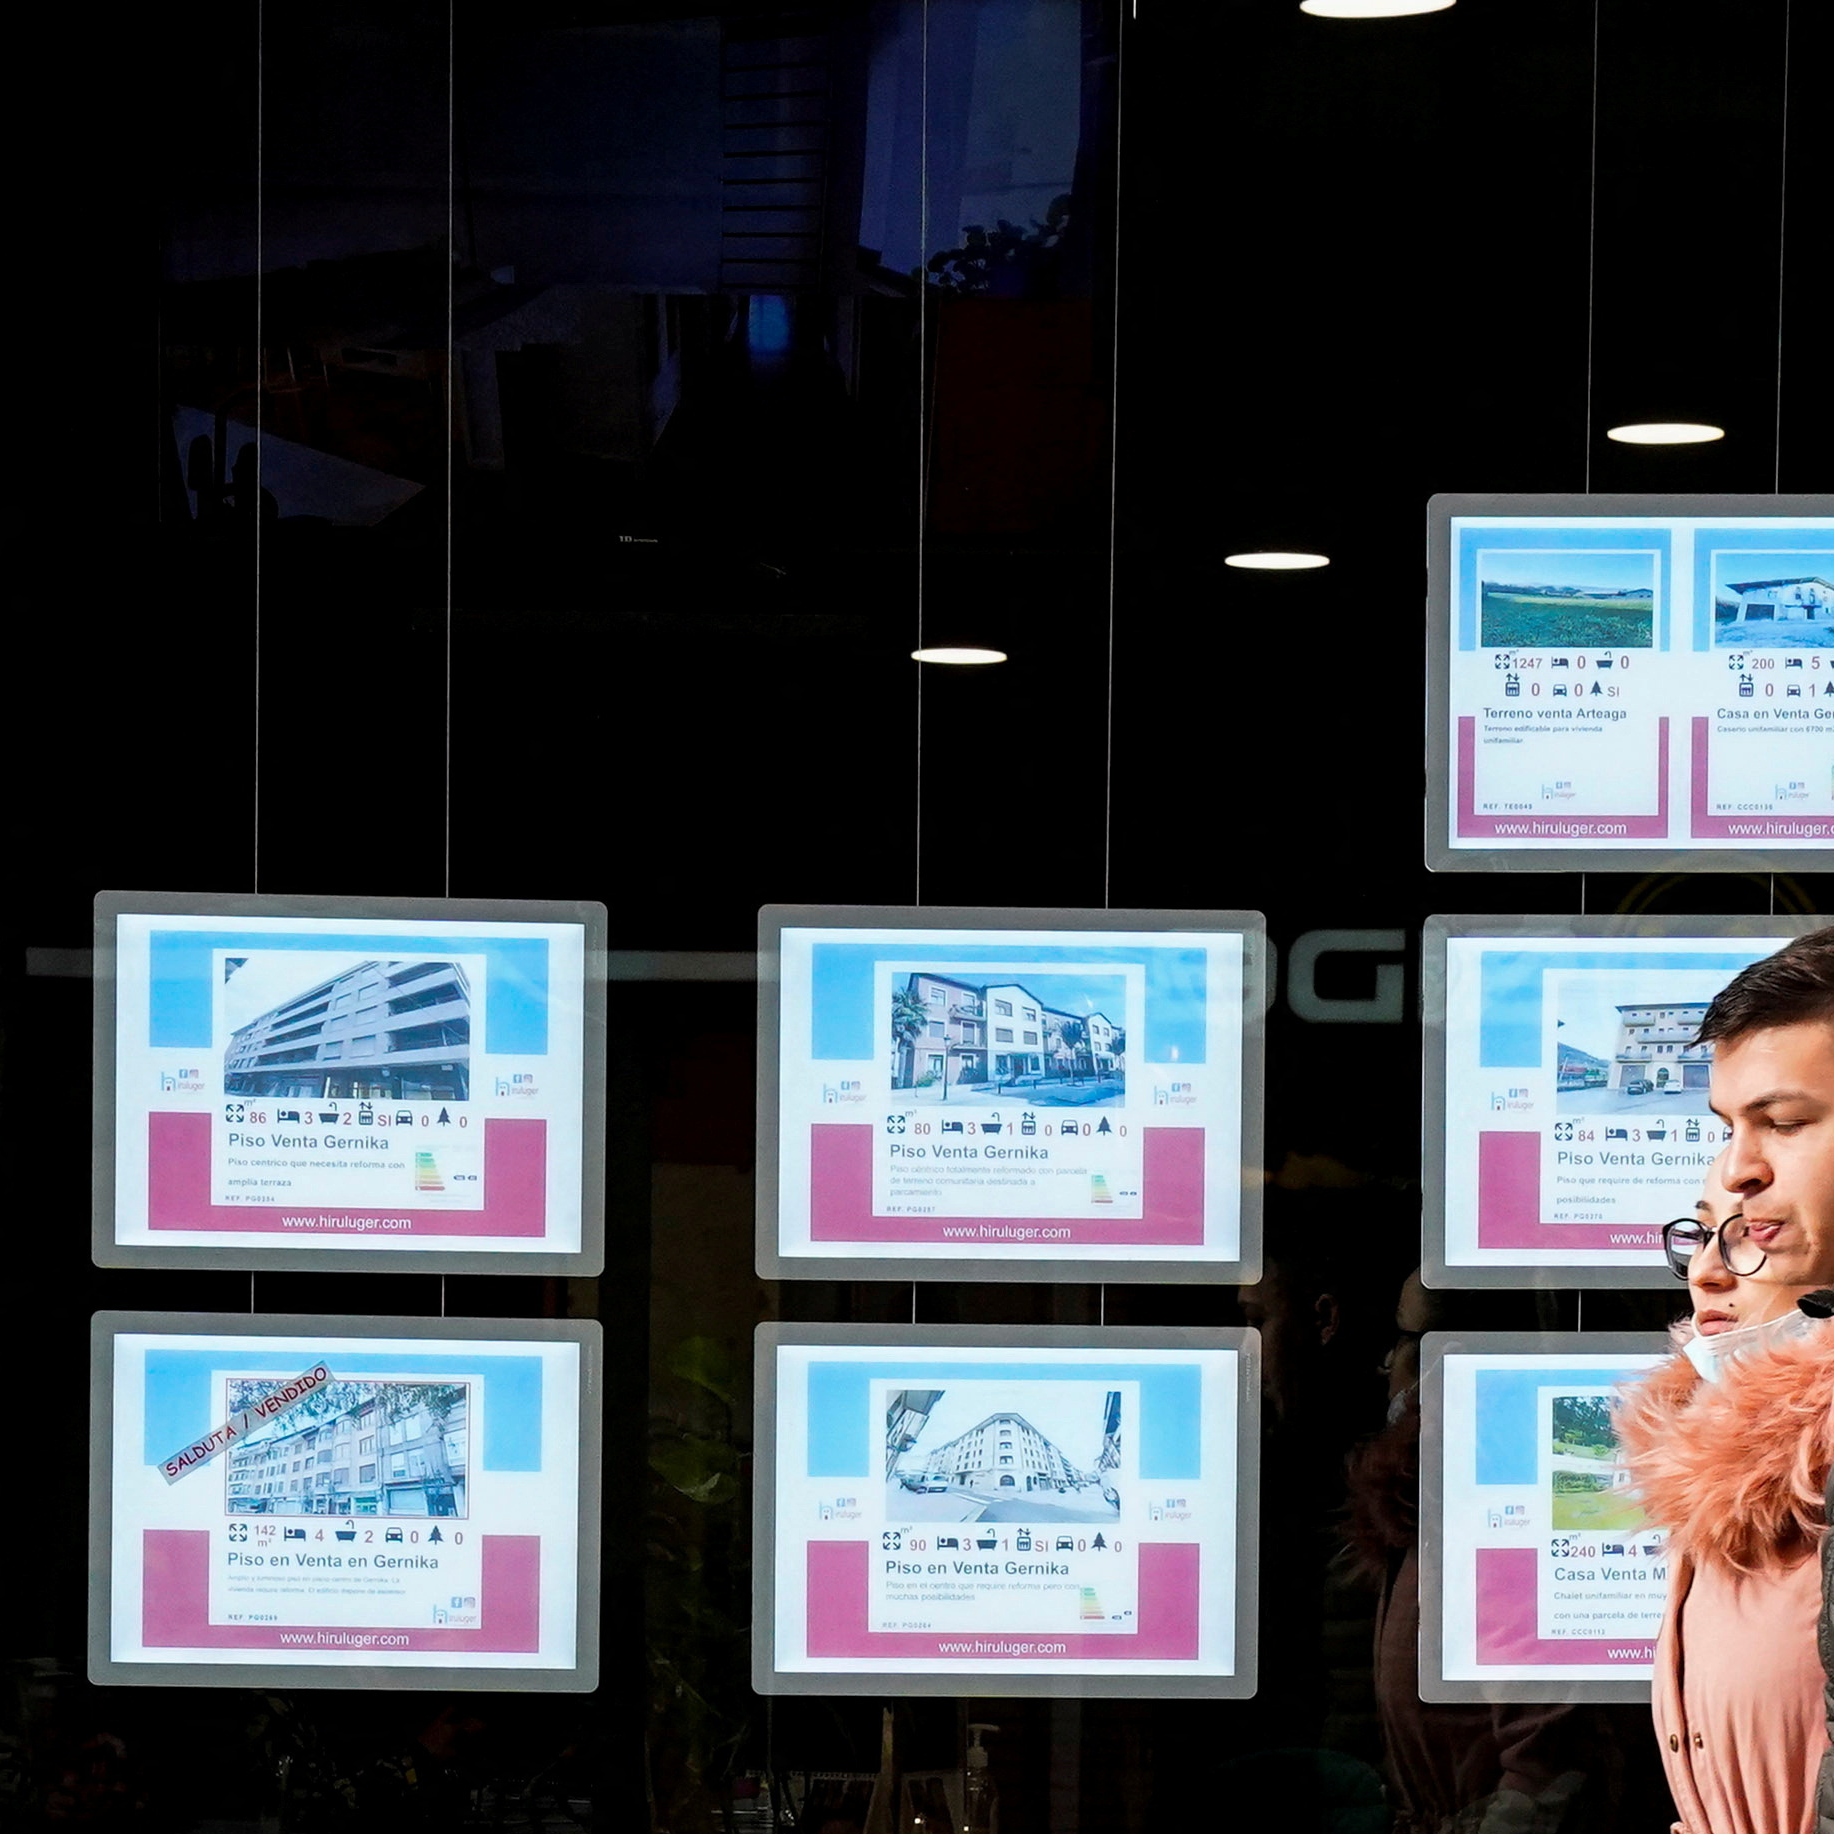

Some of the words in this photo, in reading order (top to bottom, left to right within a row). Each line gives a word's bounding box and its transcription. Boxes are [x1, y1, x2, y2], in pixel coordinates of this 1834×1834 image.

[1513, 658, 1542, 669] 1247
[1577, 656, 1586, 669] 0
[1621, 656, 1629, 669] 0
[1752, 658, 1774, 669] 200
[1812, 656, 1820, 669] 5
[1483, 708, 1533, 718] Terreno
[1538, 709, 1572, 718] venta
[1577, 708, 1626, 721] Arteaga
[1717, 708, 1749, 719] Casa
[1754, 711, 1769, 719] en
[1774, 709, 1809, 719] Venta
[1493, 822, 1629, 838] www.hiruluger.com
[229, 1133, 265, 1147] Piso
[271, 1134, 317, 1148] Venta
[324, 1135, 388, 1149] Gernika
[891, 1144, 926, 1158] Piso
[932, 1145, 977, 1158] Venta
[984, 1145, 1048, 1159] Gernika
[1558, 1152, 1593, 1165] Piso
[1600, 1152, 1644, 1165] Venta
[1651, 1152, 1715, 1166] Gernika
[280, 1216, 411, 1233] www.hiruluger.com
[943, 1226, 1070, 1240] www.hiruluger.com
[165, 1426, 238, 1478] SALDUTA
[255, 1366, 329, 1420] VENDIDO
[255, 1525, 276, 1536] 142
[315, 1529, 324, 1541] 4
[365, 1530, 373, 1543] 2
[410, 1531, 419, 1543] 0
[455, 1532, 463, 1545] 0
[228, 1552, 264, 1566] Piso
[270, 1557, 289, 1566] en
[296, 1554, 341, 1567] Venta
[348, 1558, 367, 1567] en
[374, 1555, 438, 1569] Gernika
[886, 1561, 921, 1574] Piso
[928, 1564, 946, 1574] en
[953, 1561, 998, 1574] Venta
[1005, 1562, 1068, 1575] Gernika
[1555, 1568, 1595, 1581] Casa
[1601, 1568, 1646, 1580] Venta
[281, 1632, 409, 1647] www.hiruluger.com
[939, 1641, 1065, 1656] www.hiruluger.com
